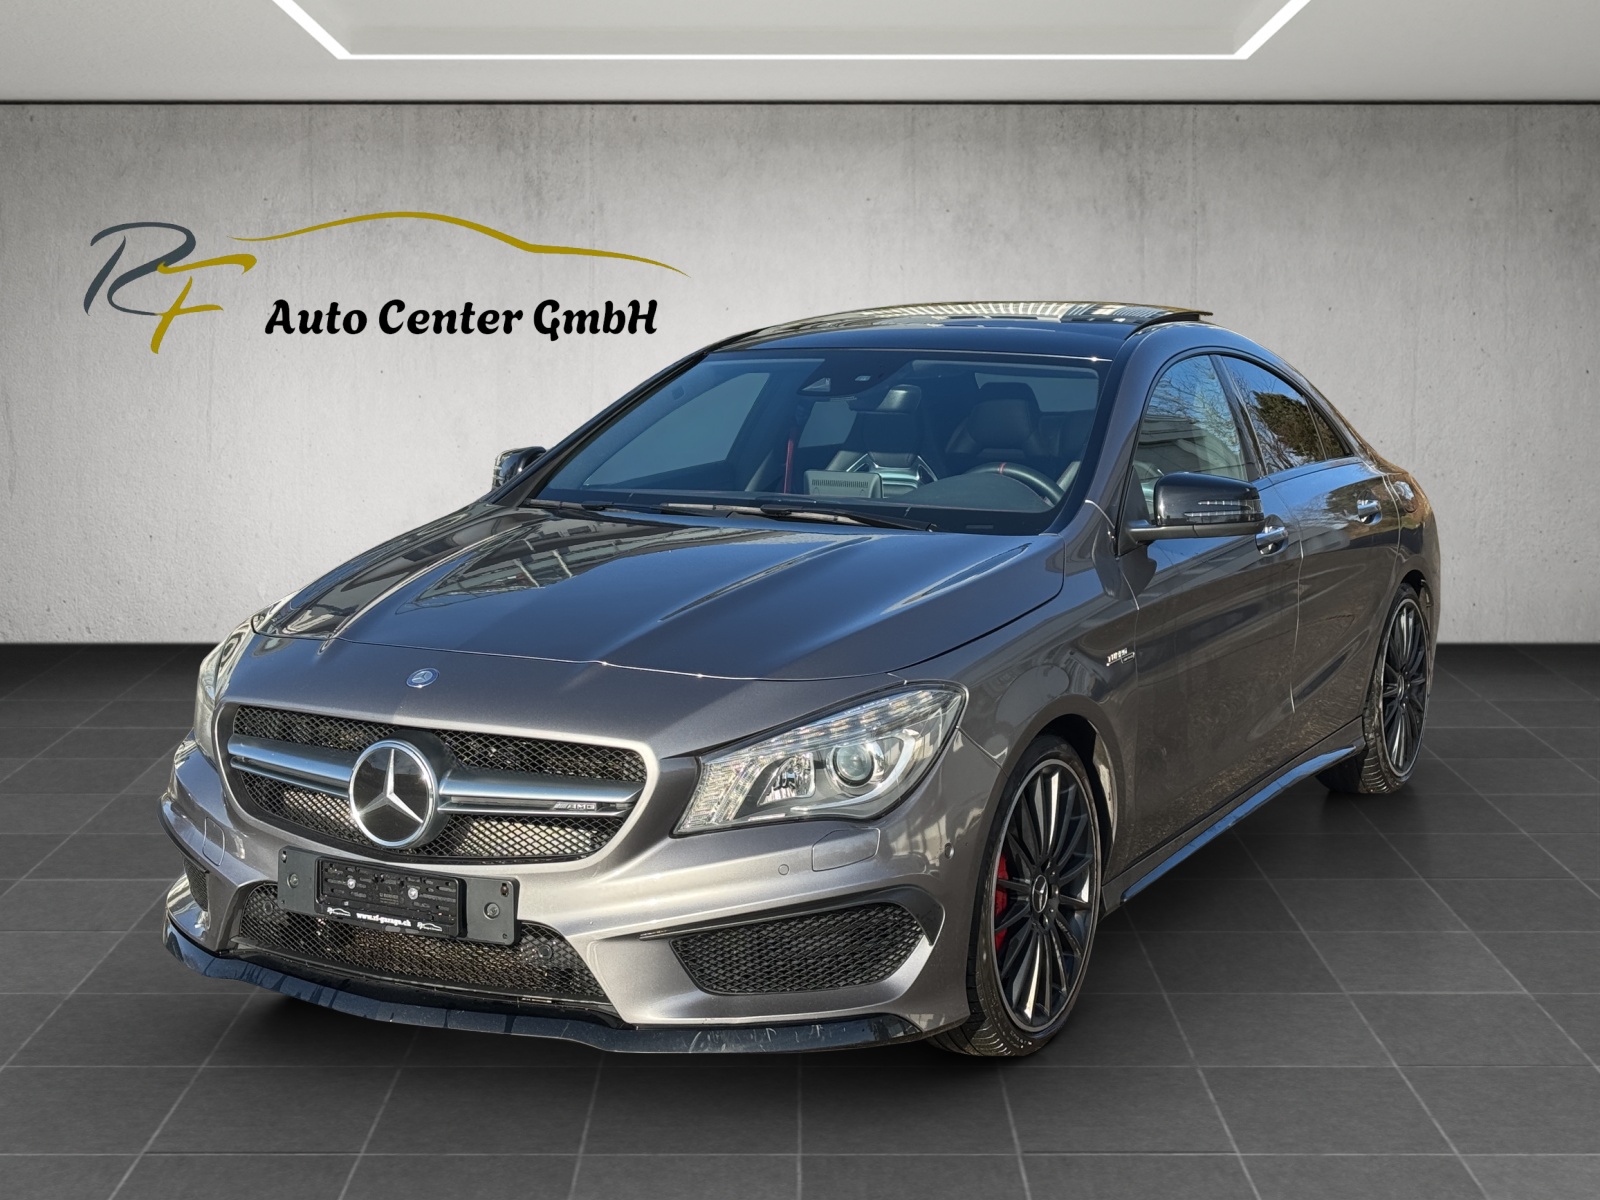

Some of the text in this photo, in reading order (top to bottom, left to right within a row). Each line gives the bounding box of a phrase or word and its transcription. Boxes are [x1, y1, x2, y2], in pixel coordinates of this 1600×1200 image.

[265, 300, 657, 341] Auto Center GmbH
